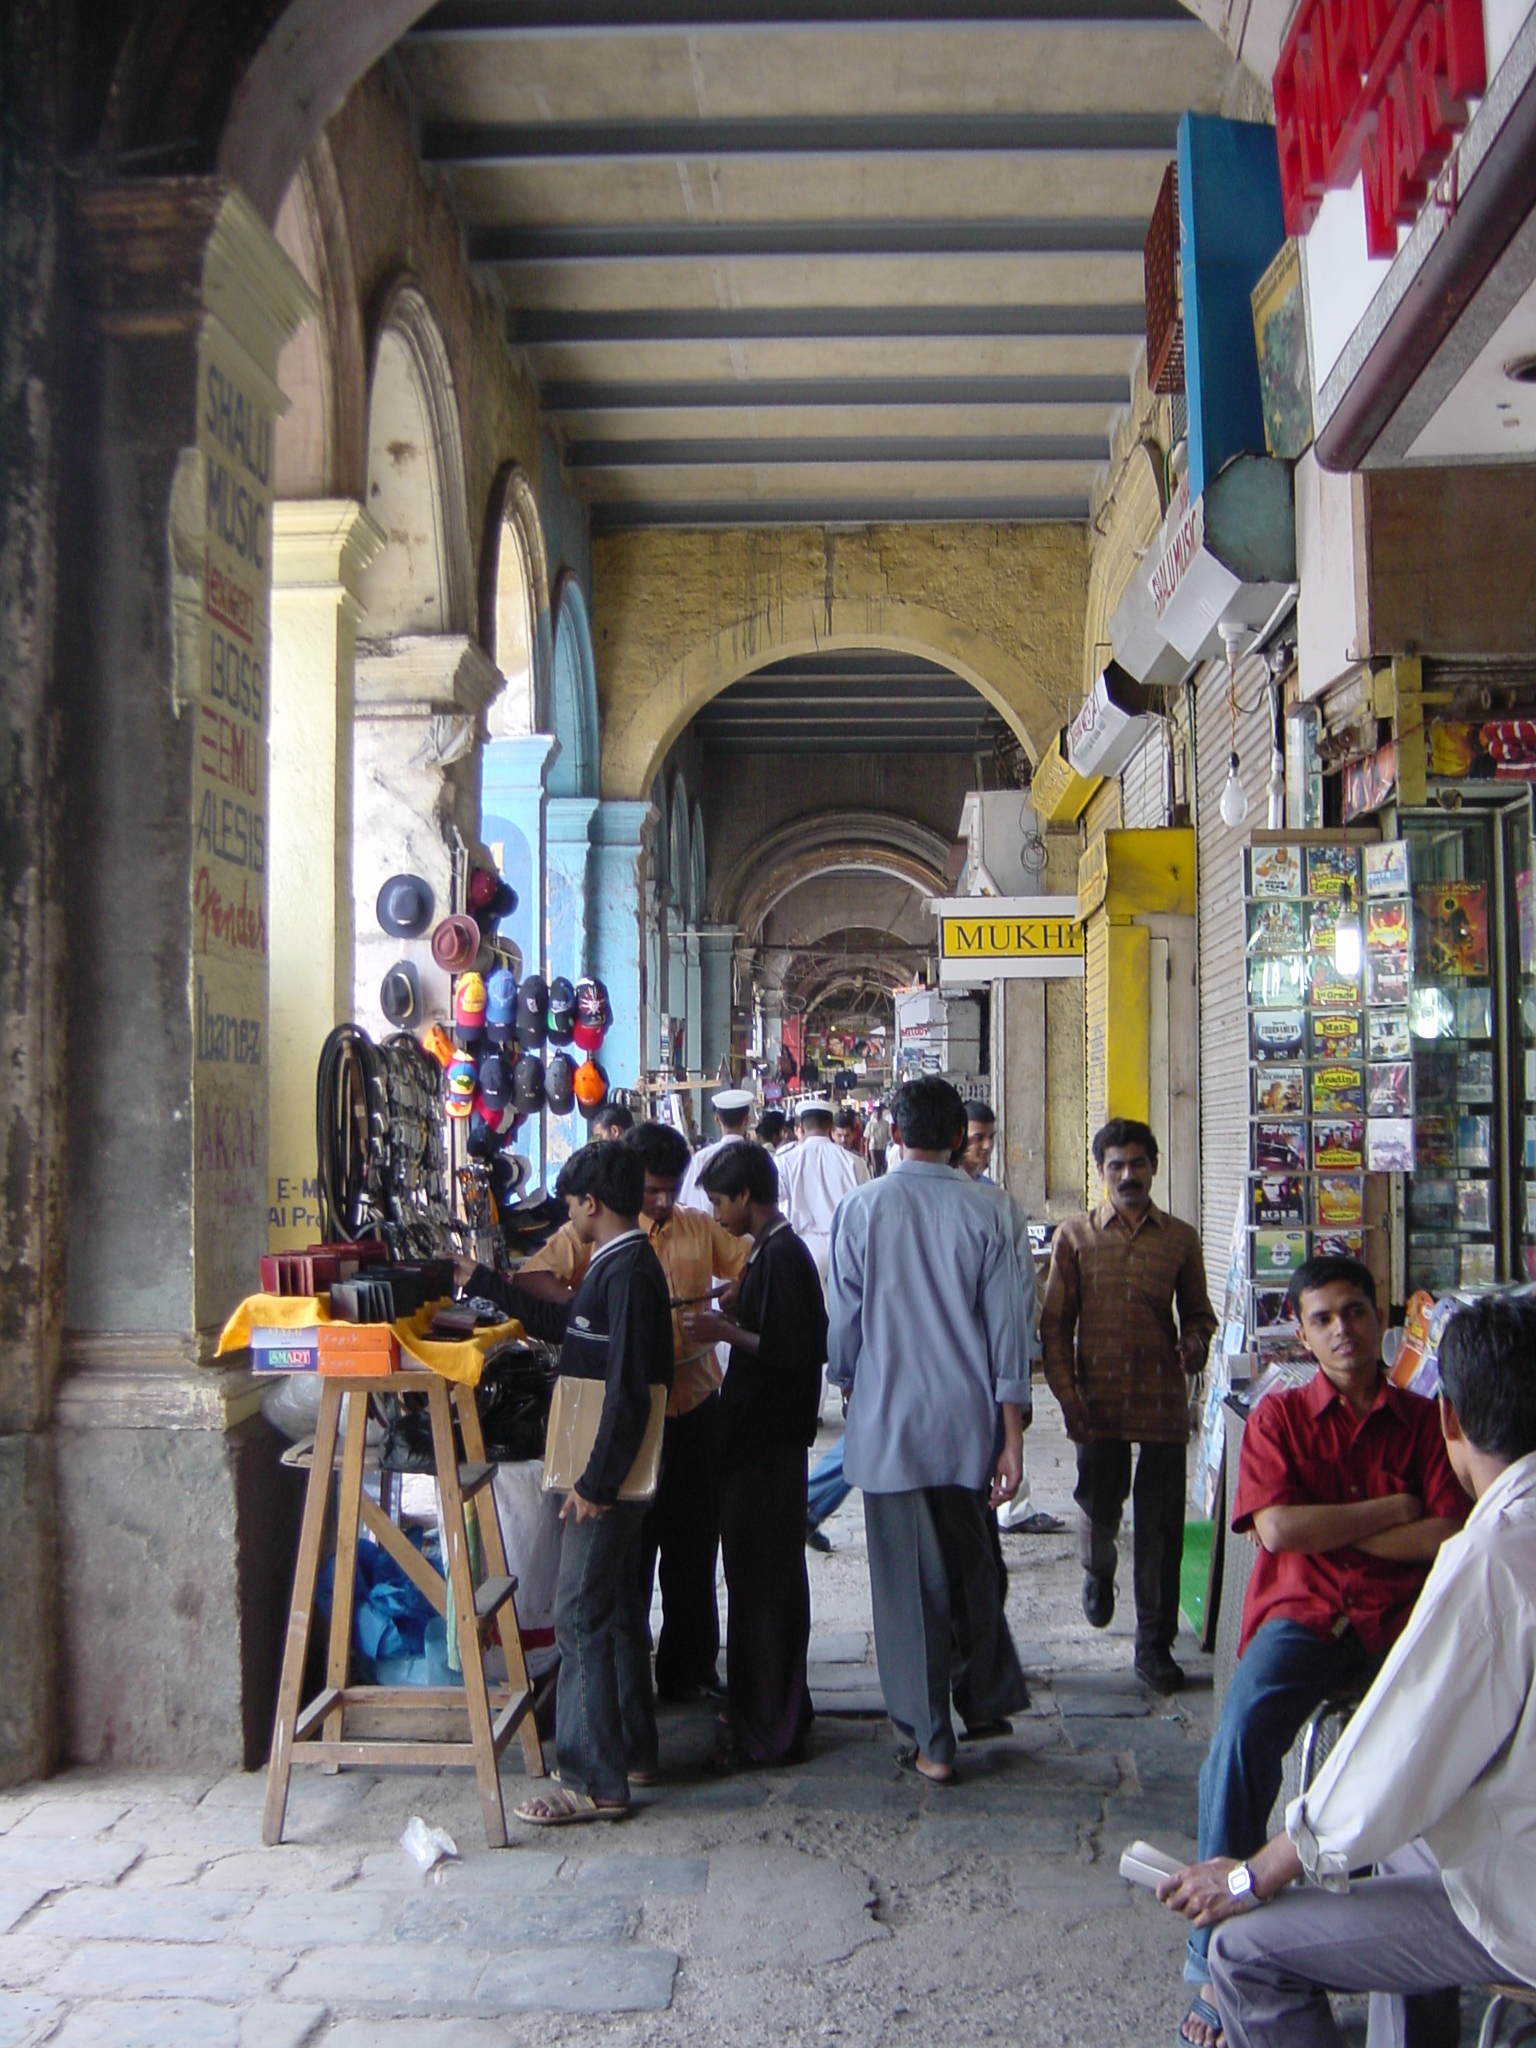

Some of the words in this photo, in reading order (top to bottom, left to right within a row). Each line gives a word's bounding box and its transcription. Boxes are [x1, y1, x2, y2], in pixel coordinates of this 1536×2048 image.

[206, 363, 270, 487] SHALU
[206, 455, 265, 570] MUSIC
[210, 629, 263, 724] BOSS
[196, 787, 265, 874] ALESIS
[192, 865, 267, 956] Fender
[955, 923, 1075, 952] MUKHI
[197, 973, 261, 1066] Ibanez
[199, 1101, 255, 1172] AKAI
